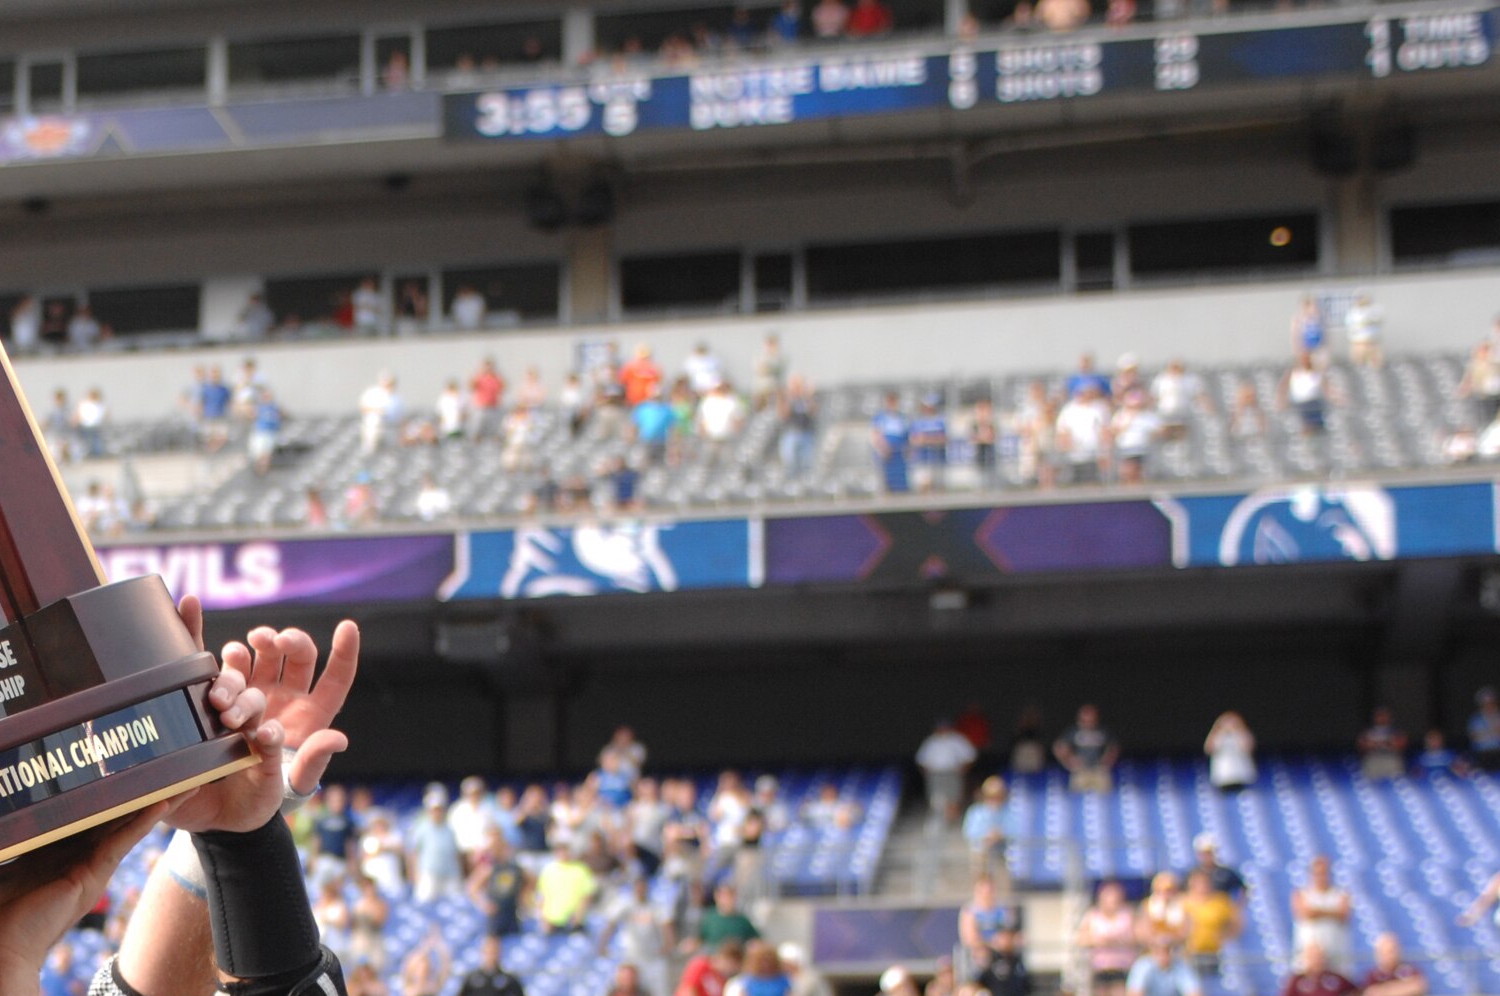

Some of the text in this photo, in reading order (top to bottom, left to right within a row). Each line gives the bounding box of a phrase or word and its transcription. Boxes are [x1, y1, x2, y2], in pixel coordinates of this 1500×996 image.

[690, 97, 795, 131] DUKE
[108, 541, 283, 600] EVILS
[69, 715, 160, 769] CHAMPION
